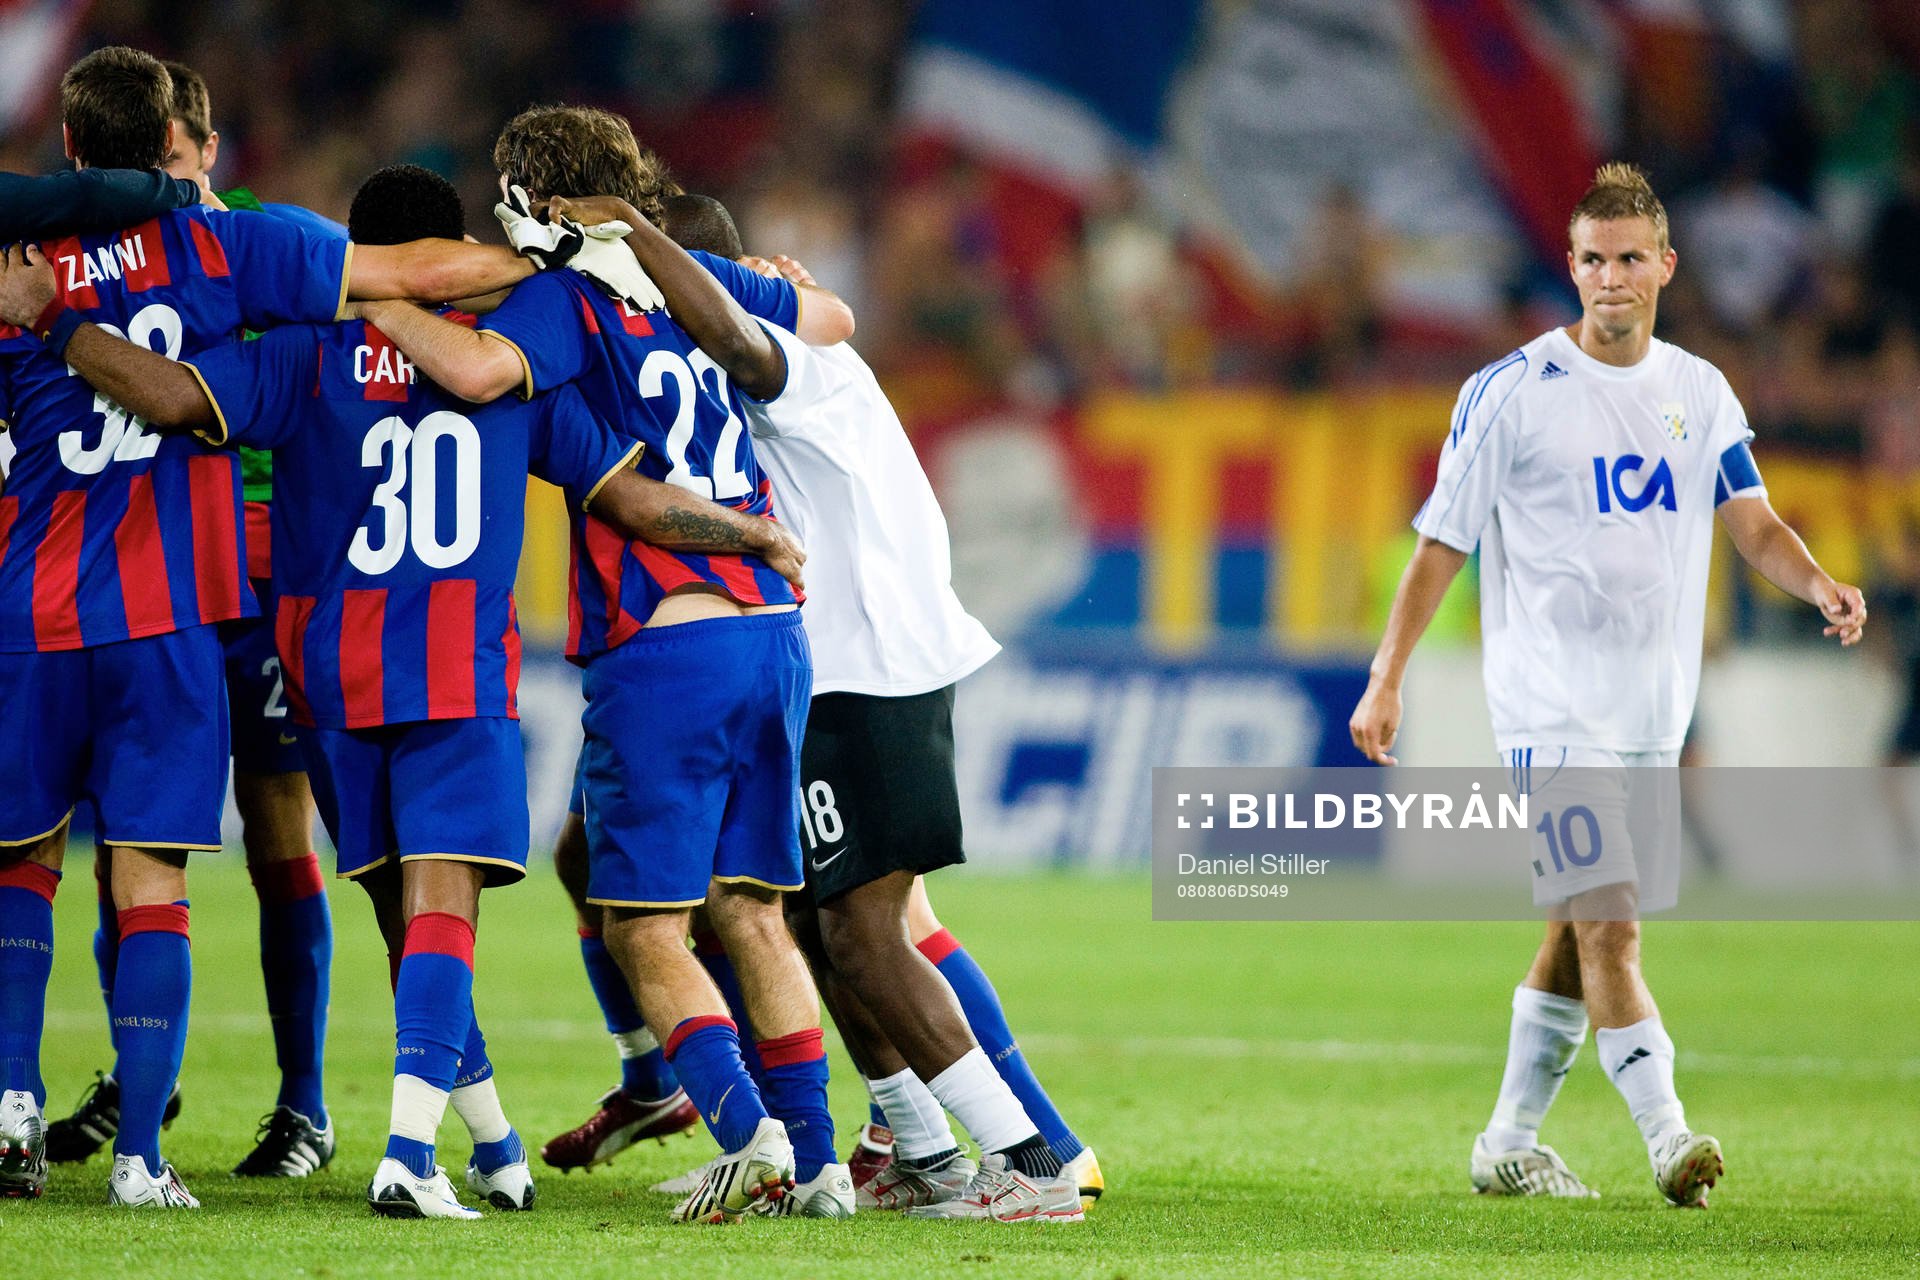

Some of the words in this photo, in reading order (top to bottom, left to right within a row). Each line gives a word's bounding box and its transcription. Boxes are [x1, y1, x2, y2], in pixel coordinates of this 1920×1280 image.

[59, 234, 146, 292] ZANNI
[354, 345, 417, 385] CAR
[638, 347, 753, 500] 22
[347, 410, 482, 576] 30
[1593, 454, 1677, 513] ICA
[800, 780, 844, 849] 18
[1536, 805, 1602, 873] 10
